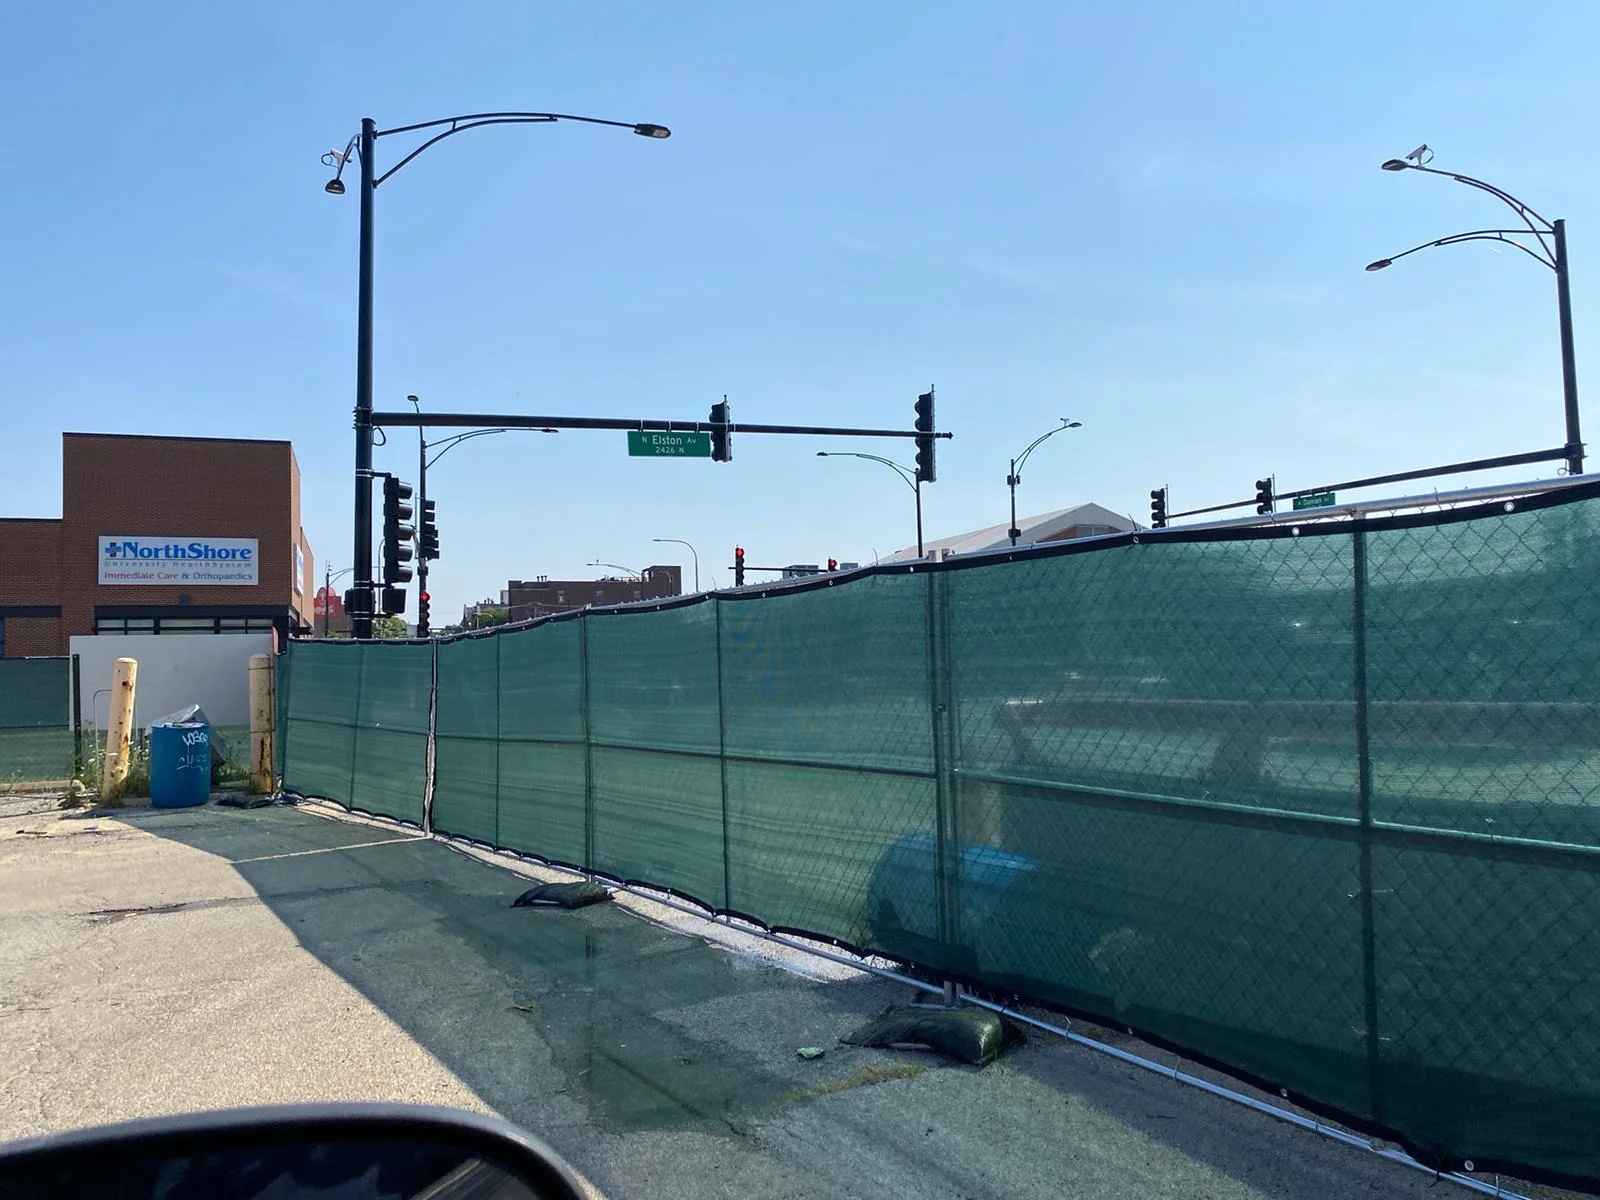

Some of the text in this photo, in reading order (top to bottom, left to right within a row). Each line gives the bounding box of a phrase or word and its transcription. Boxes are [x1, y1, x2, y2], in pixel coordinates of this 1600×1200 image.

[641, 436, 648, 444] N
[652, 435, 682, 445] Elston
[655, 446, 675, 454] 2426
[122, 541, 252, 559] NorthShore
[104, 571, 253, 581] Immediate Care & Orthopaedics
